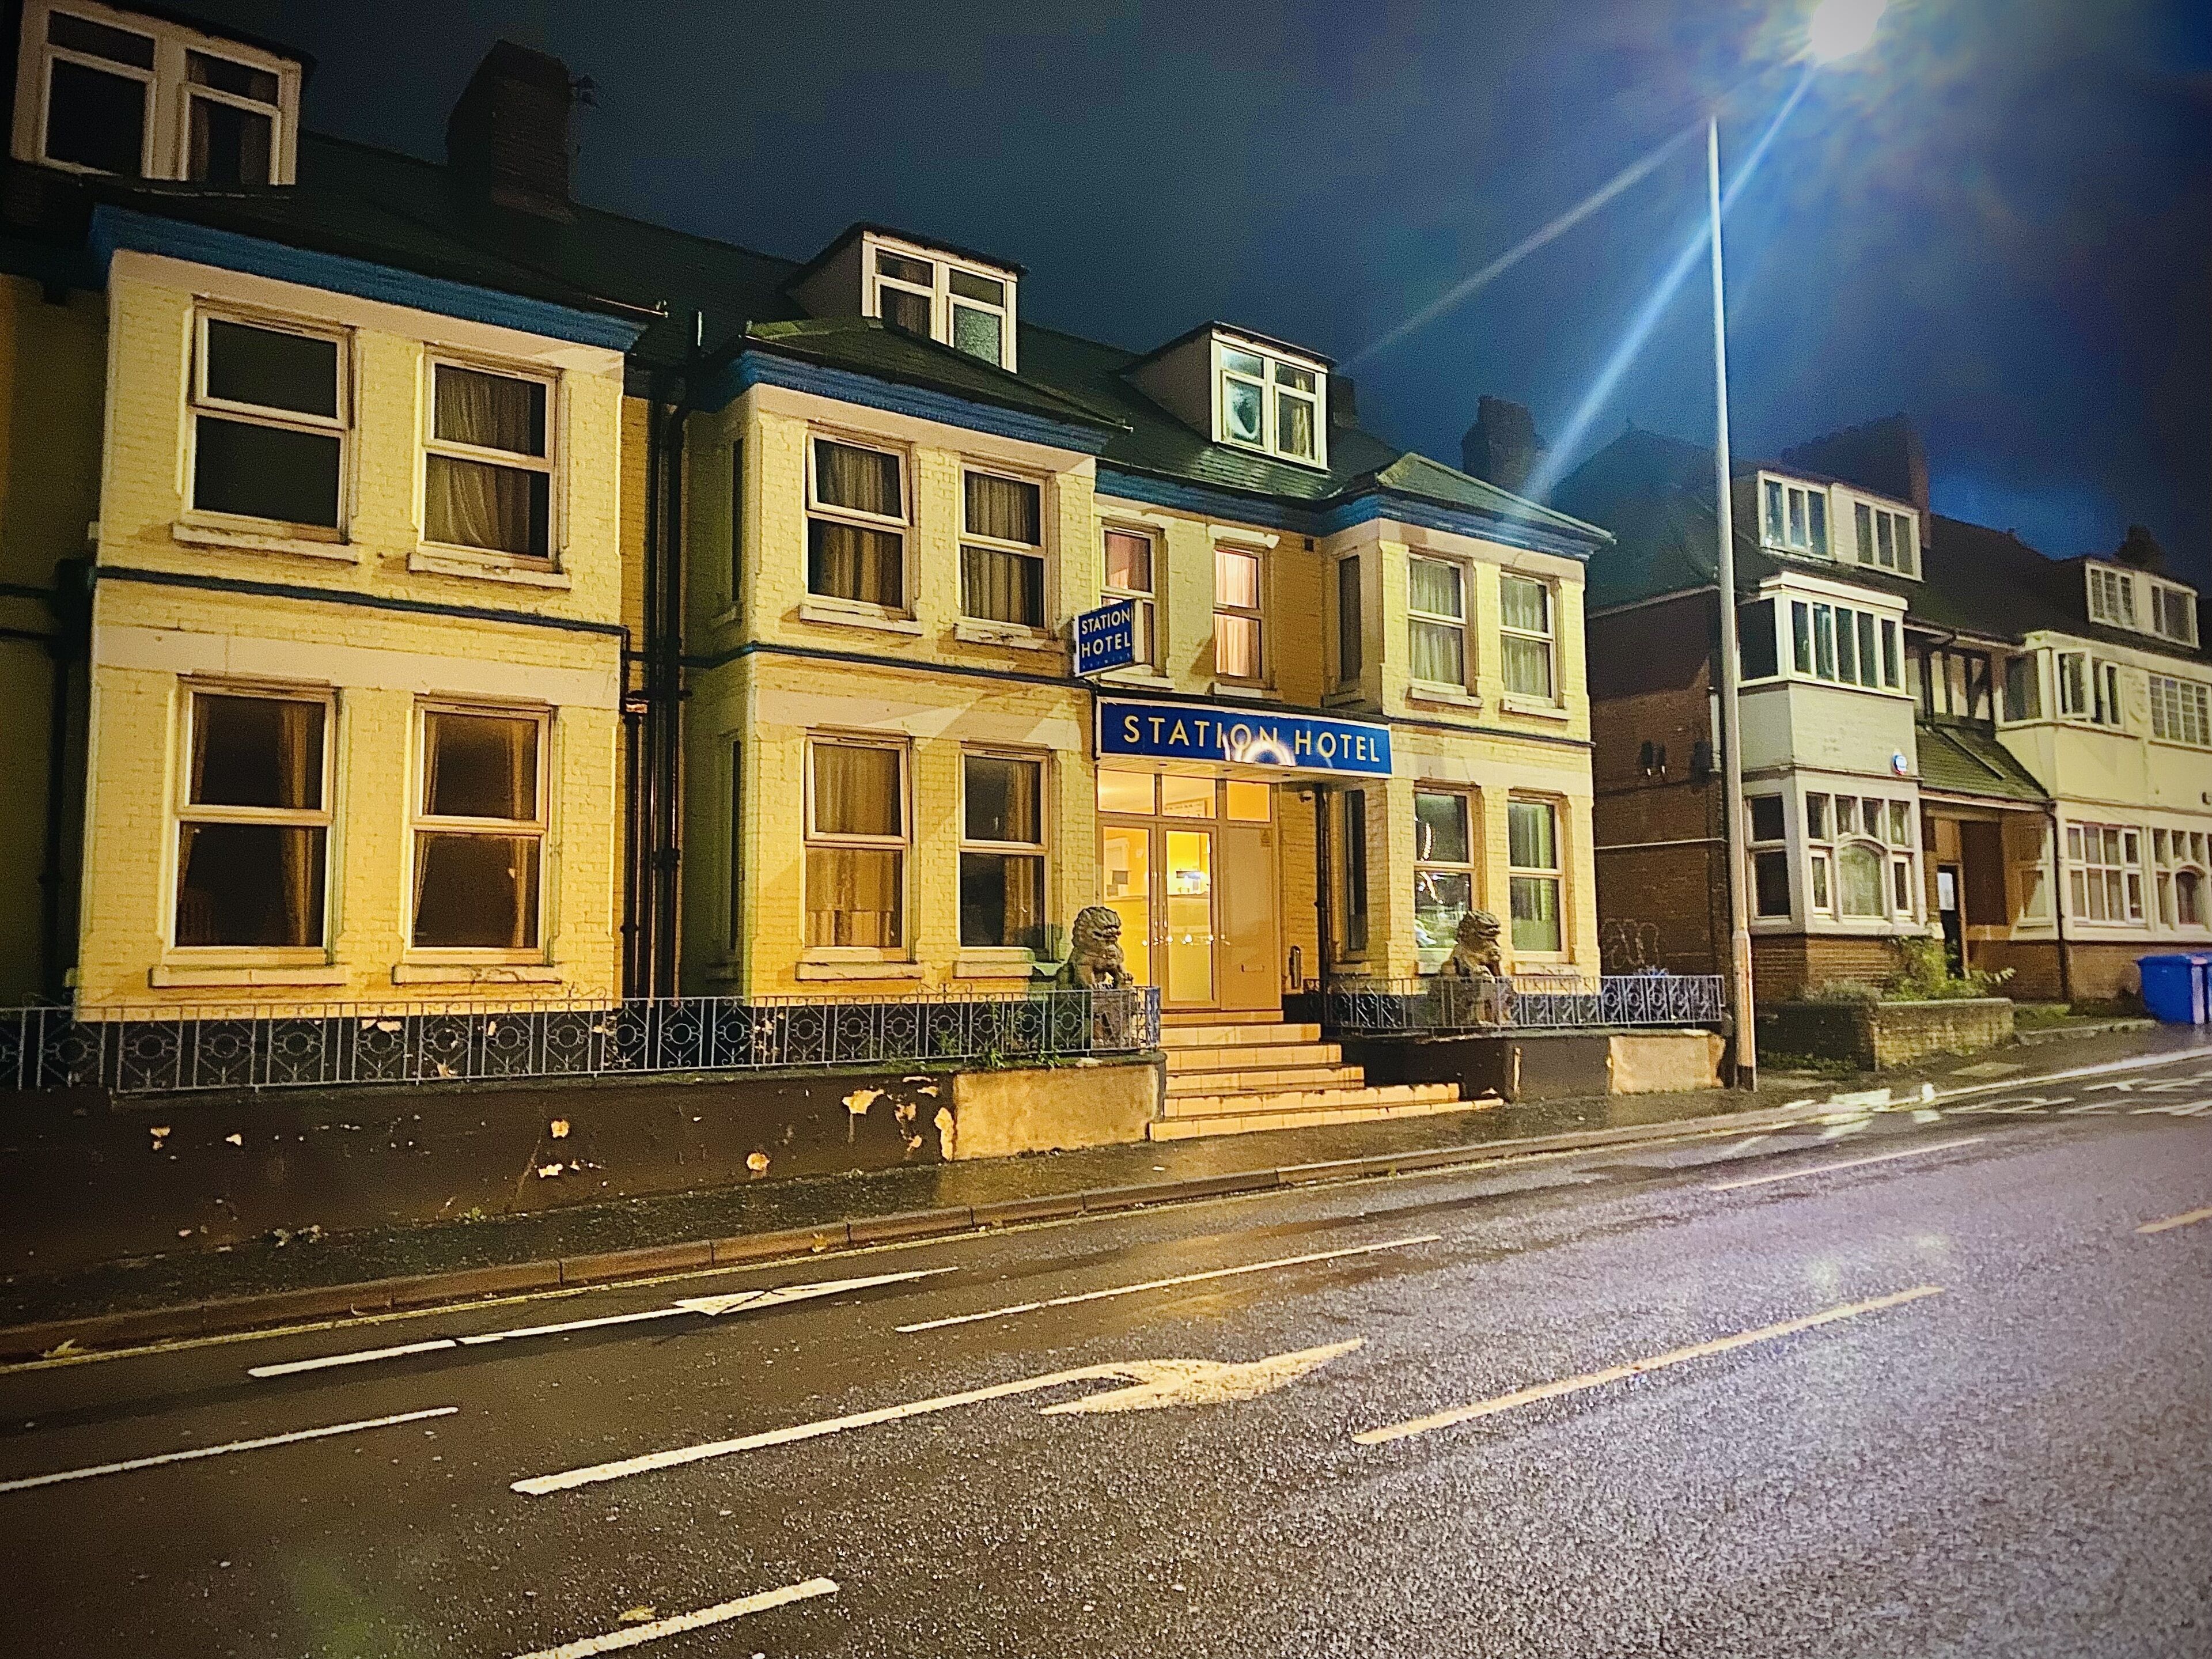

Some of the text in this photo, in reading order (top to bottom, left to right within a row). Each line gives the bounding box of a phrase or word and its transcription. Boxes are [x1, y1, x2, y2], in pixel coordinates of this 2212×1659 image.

[1081, 608, 1130, 635] STATION
[1081, 631, 1131, 658] HOTEL
[1123, 715, 1380, 763] STATION HOTEL
